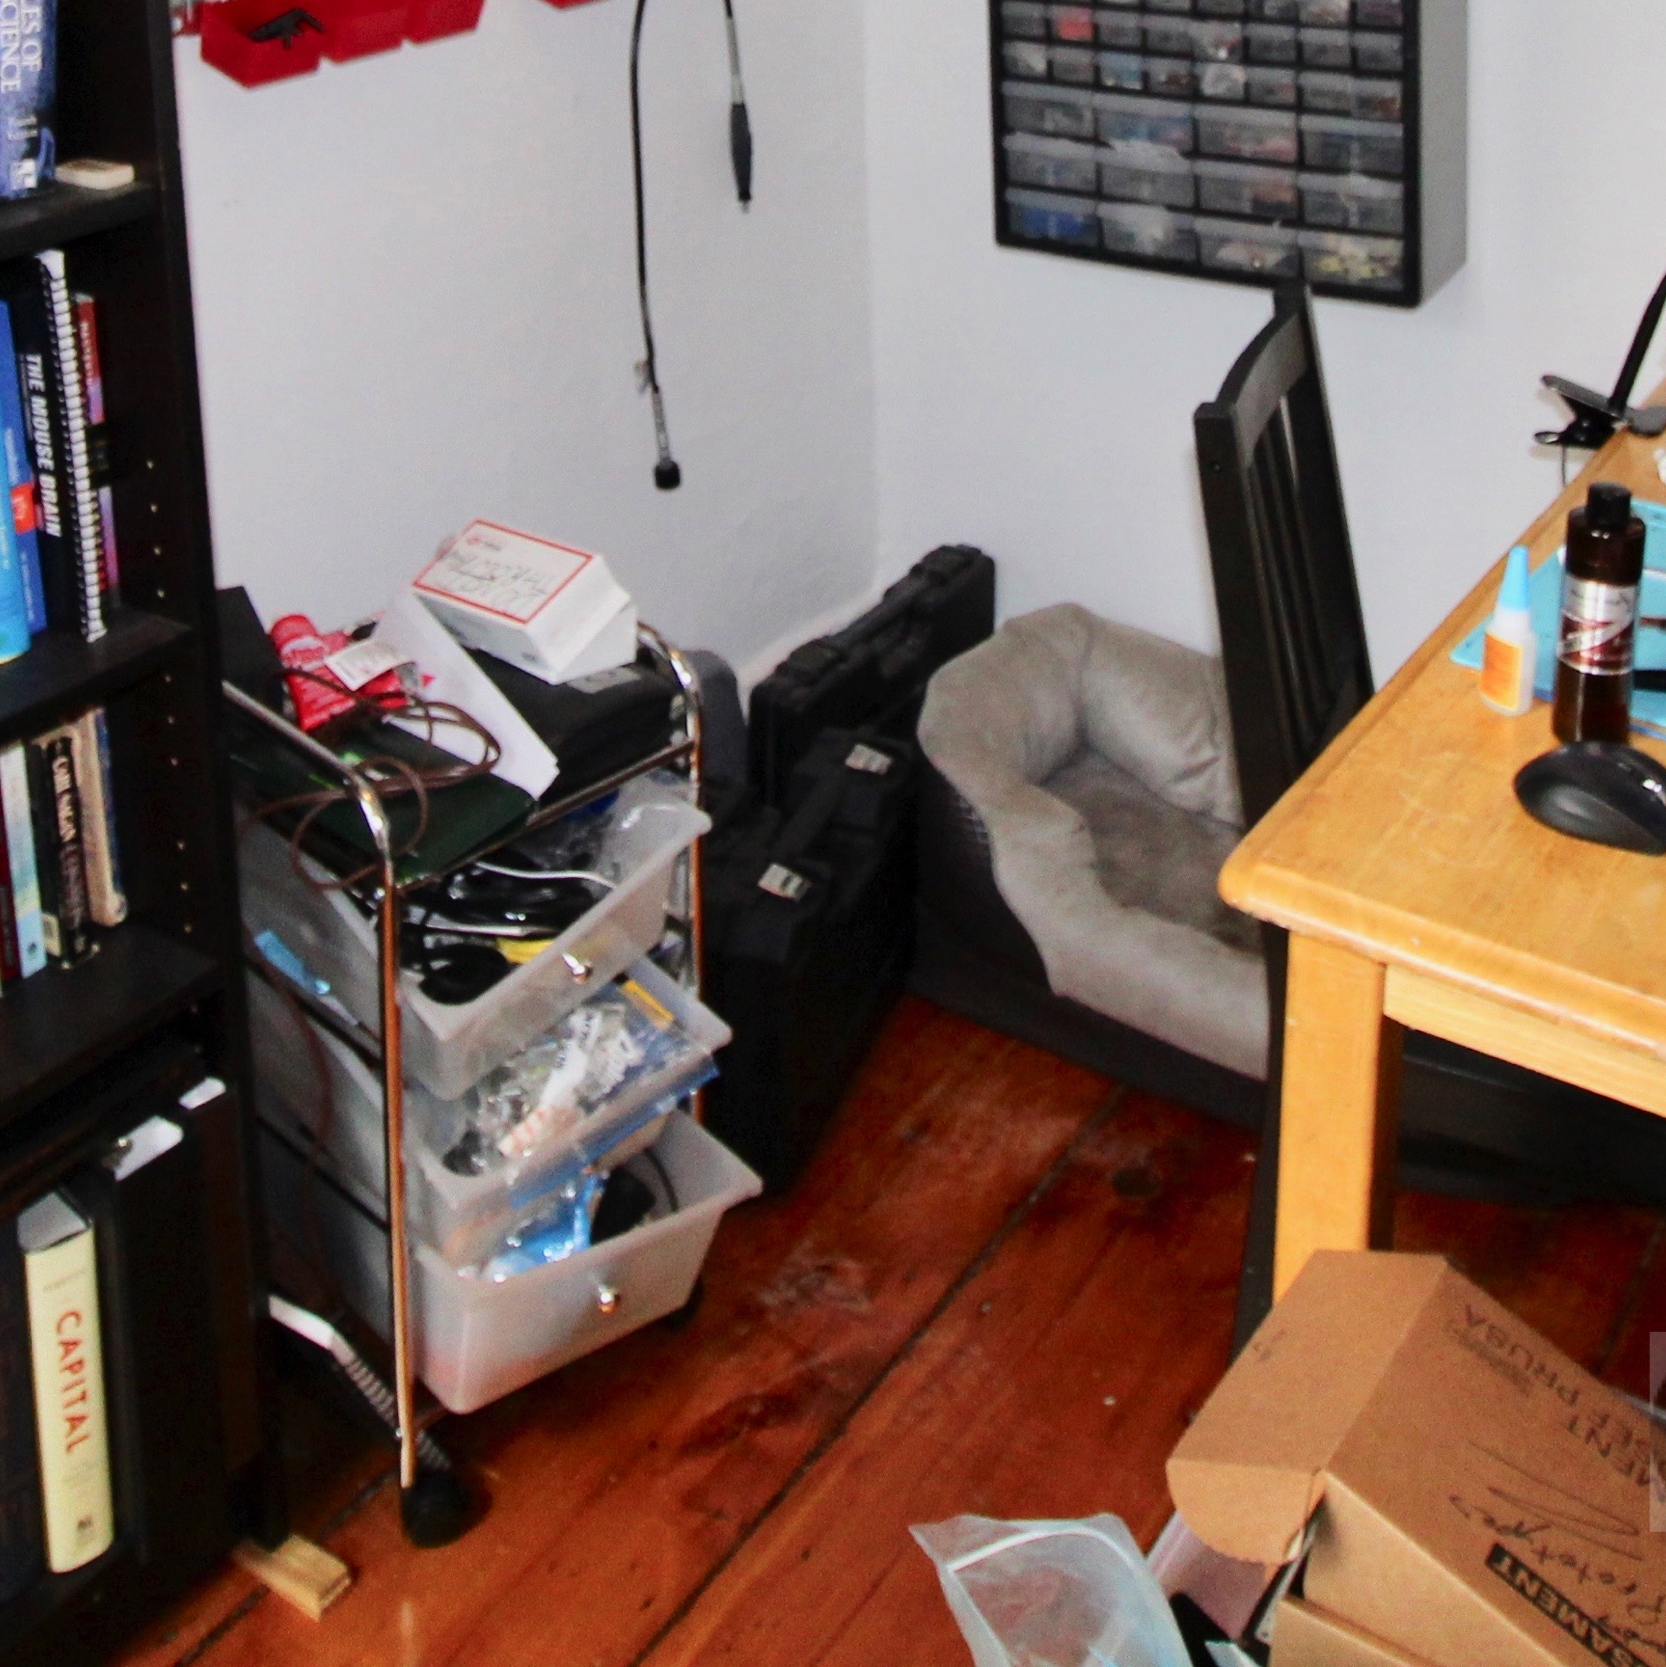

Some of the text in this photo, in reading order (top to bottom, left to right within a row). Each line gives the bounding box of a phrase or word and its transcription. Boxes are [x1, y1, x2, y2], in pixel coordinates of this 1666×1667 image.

[21, 49, 42, 72] OF
[25, 354, 60, 536] THE MOUSE BRAIN
[55, 1310, 90, 1453] CAPITAL
[1462, 1304, 1580, 1407] PRUSA
